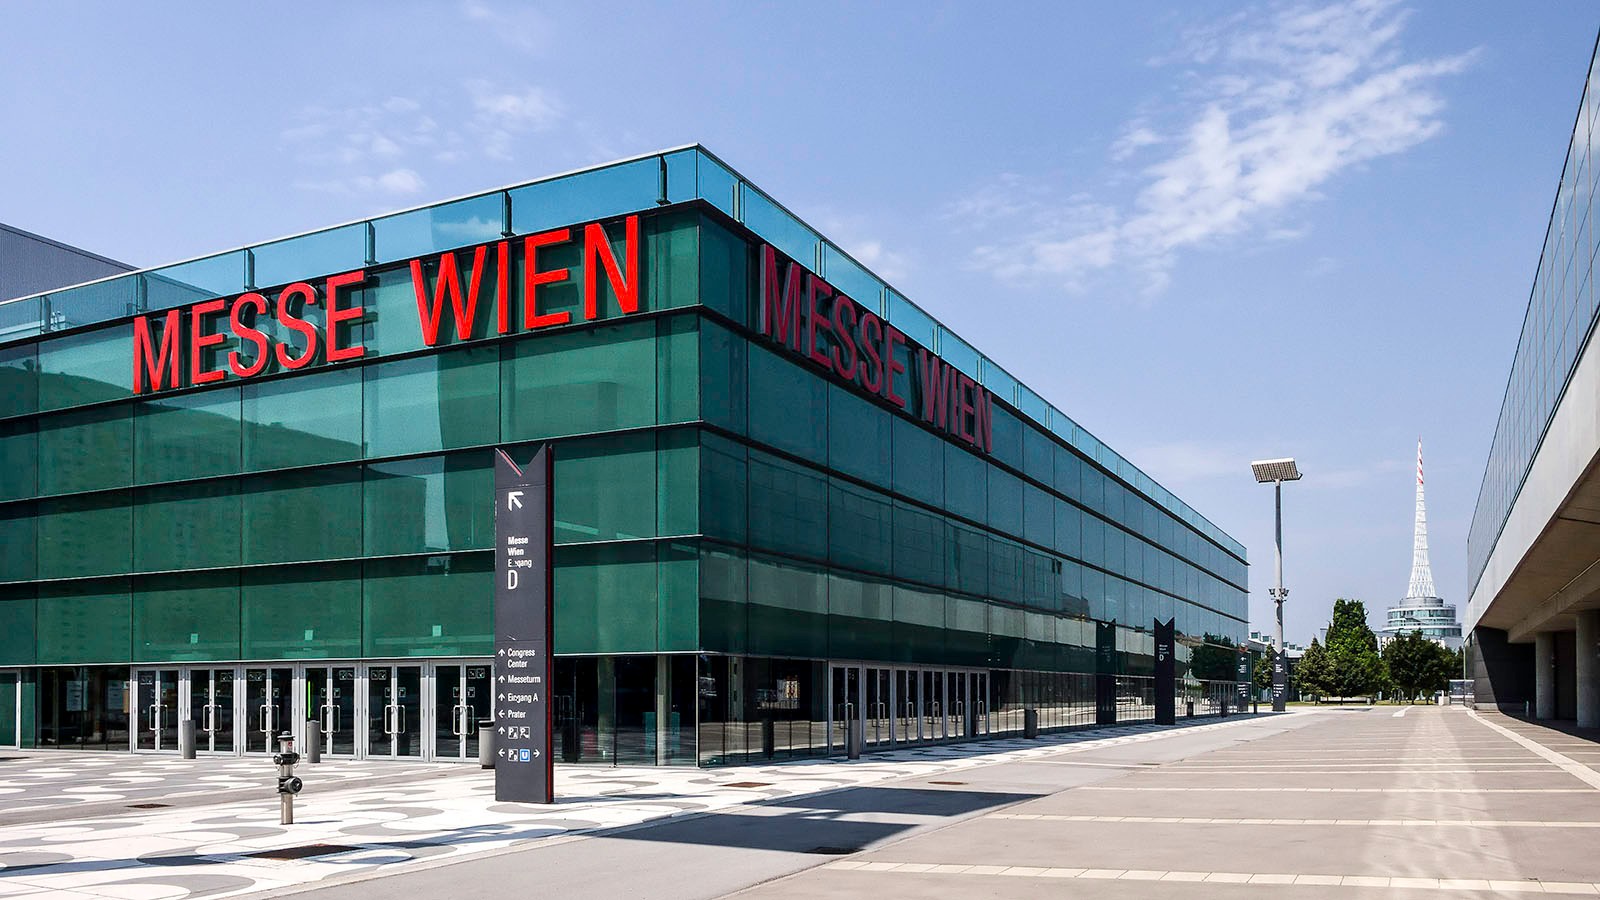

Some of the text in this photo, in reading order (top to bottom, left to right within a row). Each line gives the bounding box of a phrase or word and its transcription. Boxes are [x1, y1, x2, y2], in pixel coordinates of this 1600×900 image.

[133, 214, 639, 395] MESSE WIEN
[760, 243, 992, 453] MESSE WIEN
[507, 536, 529, 545] Messe
[507, 547, 525, 556] Wien
[507, 569, 518, 590] D
[507, 647, 536, 658] Congress
[507, 658, 528, 669] Center
[507, 674, 541, 684] Messeturm
[533, 692, 539, 702] A
[507, 709, 527, 719] Prater
